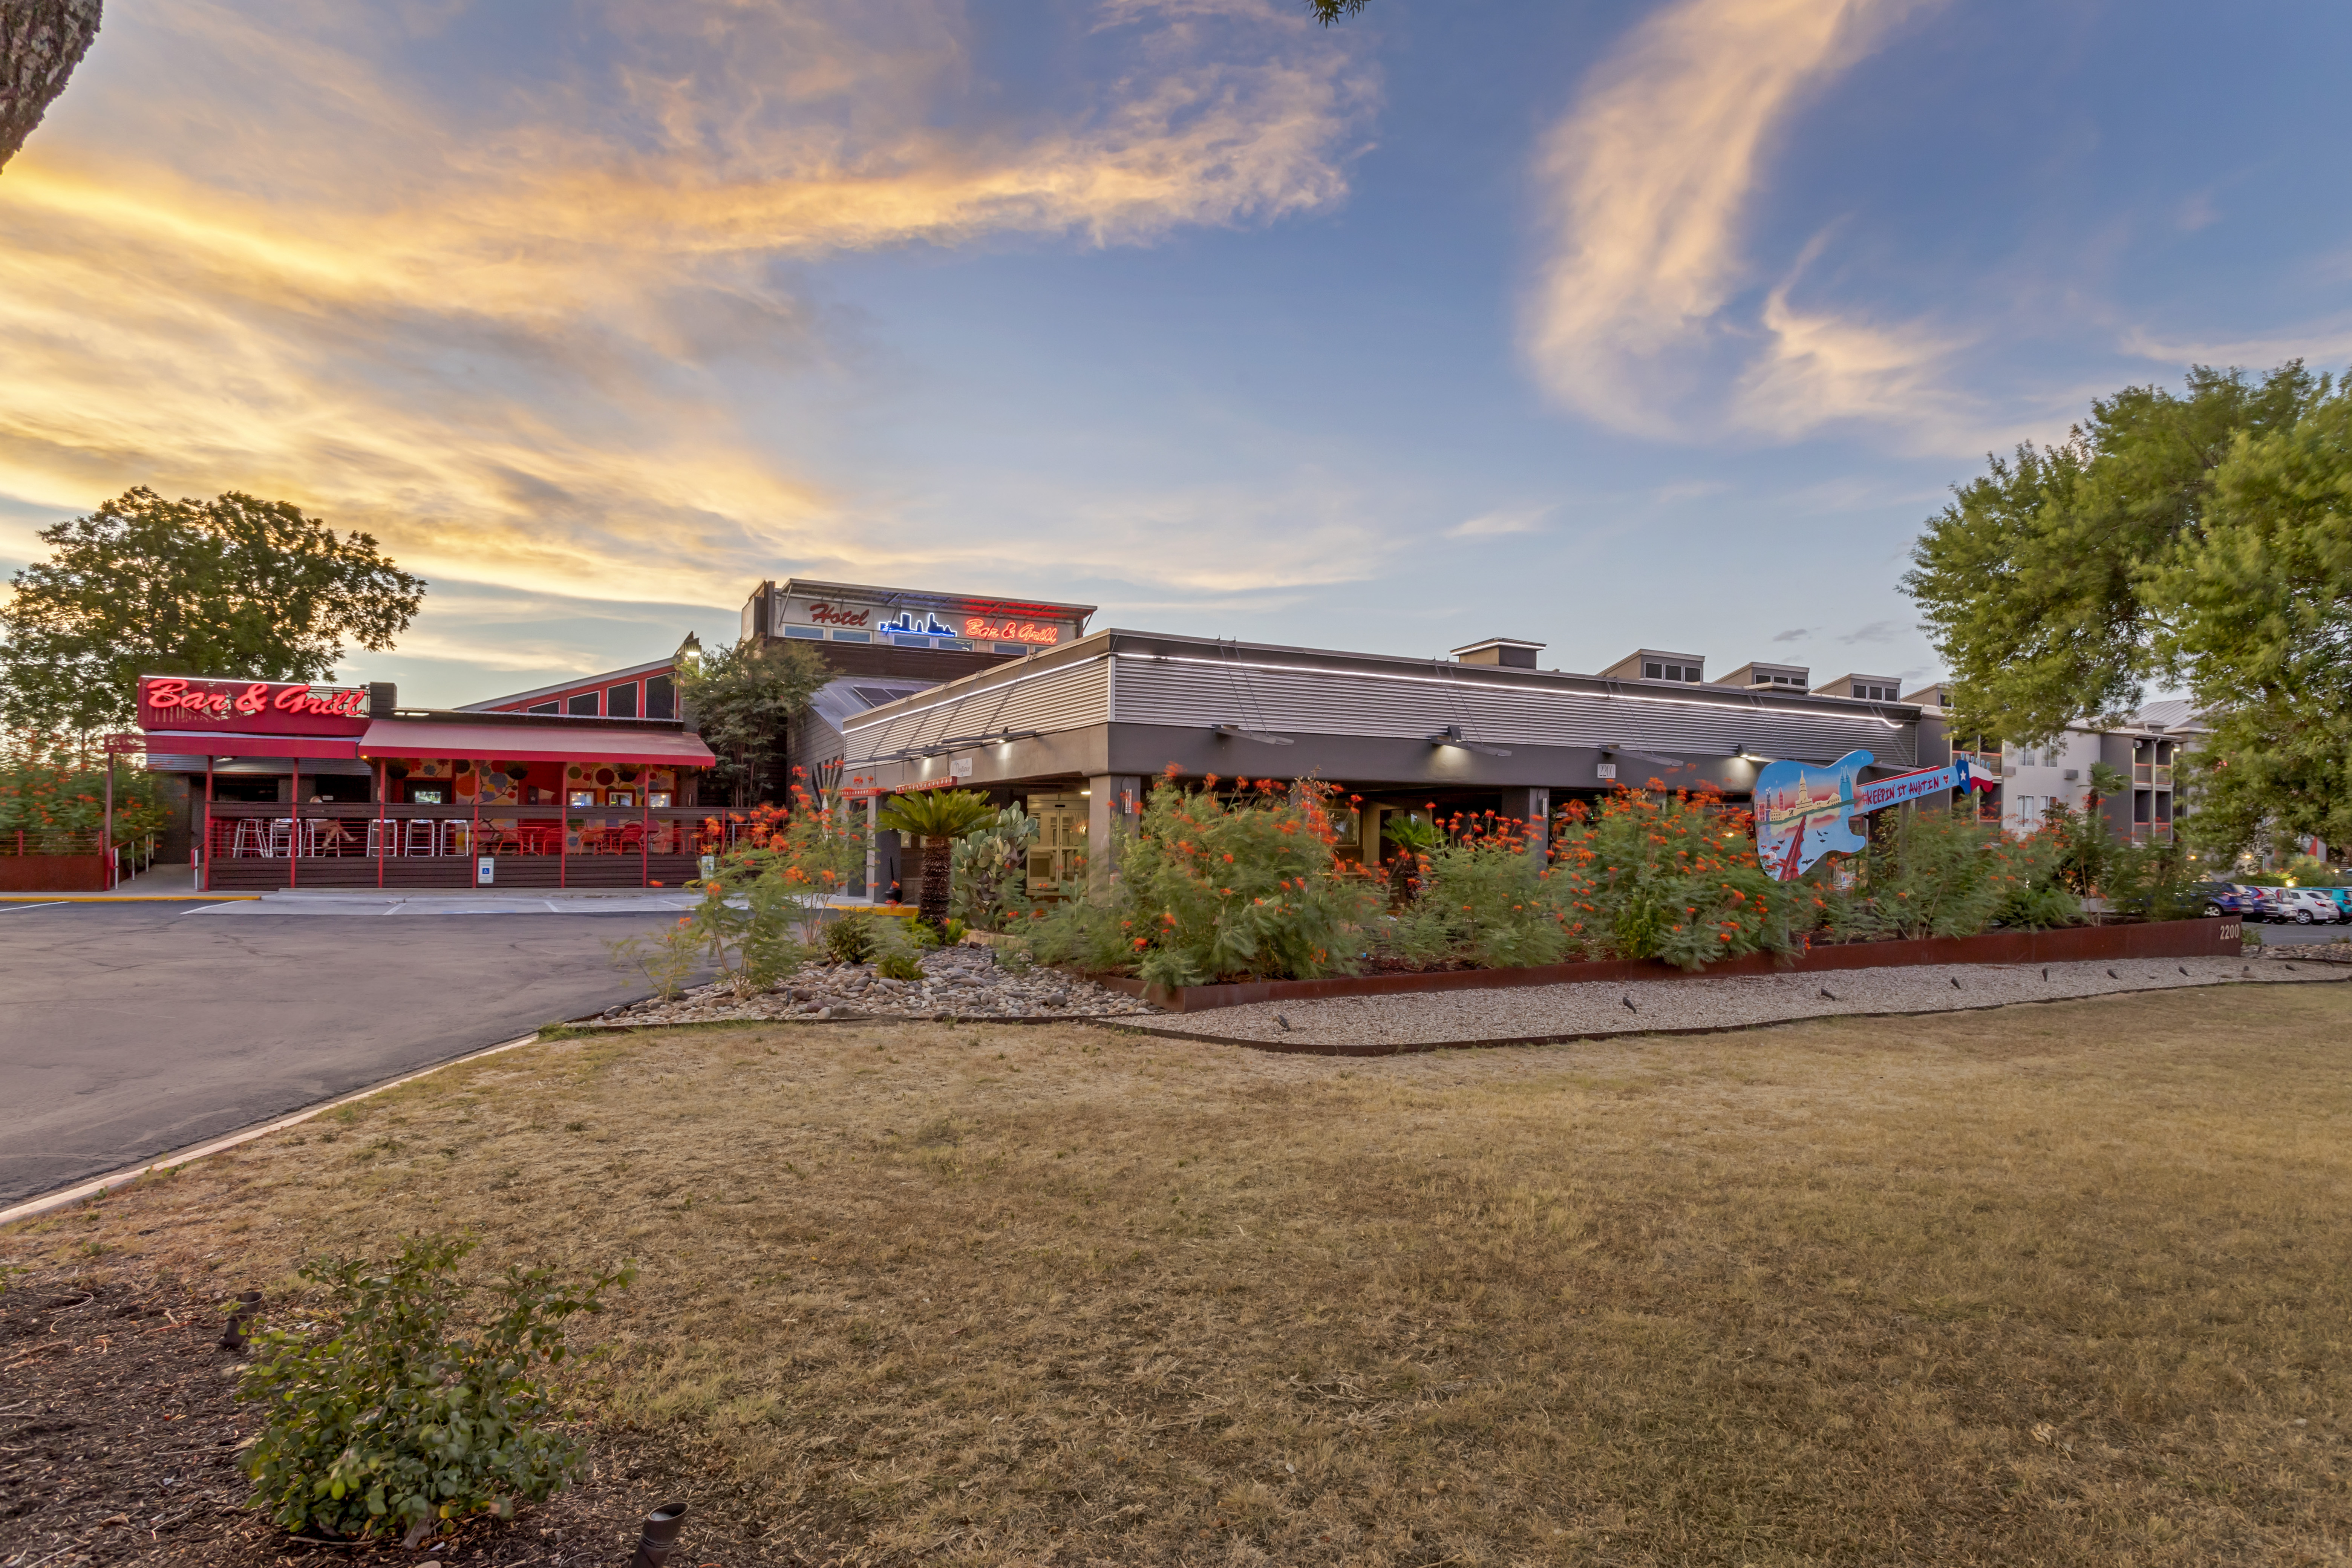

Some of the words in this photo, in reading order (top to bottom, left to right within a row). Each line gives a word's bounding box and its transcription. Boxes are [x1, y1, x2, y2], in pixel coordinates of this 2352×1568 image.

[810, 603, 869, 626] Hotel
[966, 619, 999, 638] Bar
[1002, 622, 1016, 639] &
[1018, 624, 1057, 643] Grill
[147, 678, 228, 711] Bar
[235, 683, 268, 712] &
[274, 684, 365, 715] Grill
[1599, 765, 1614, 777] 2200
[2220, 924, 2239, 940] 2200
